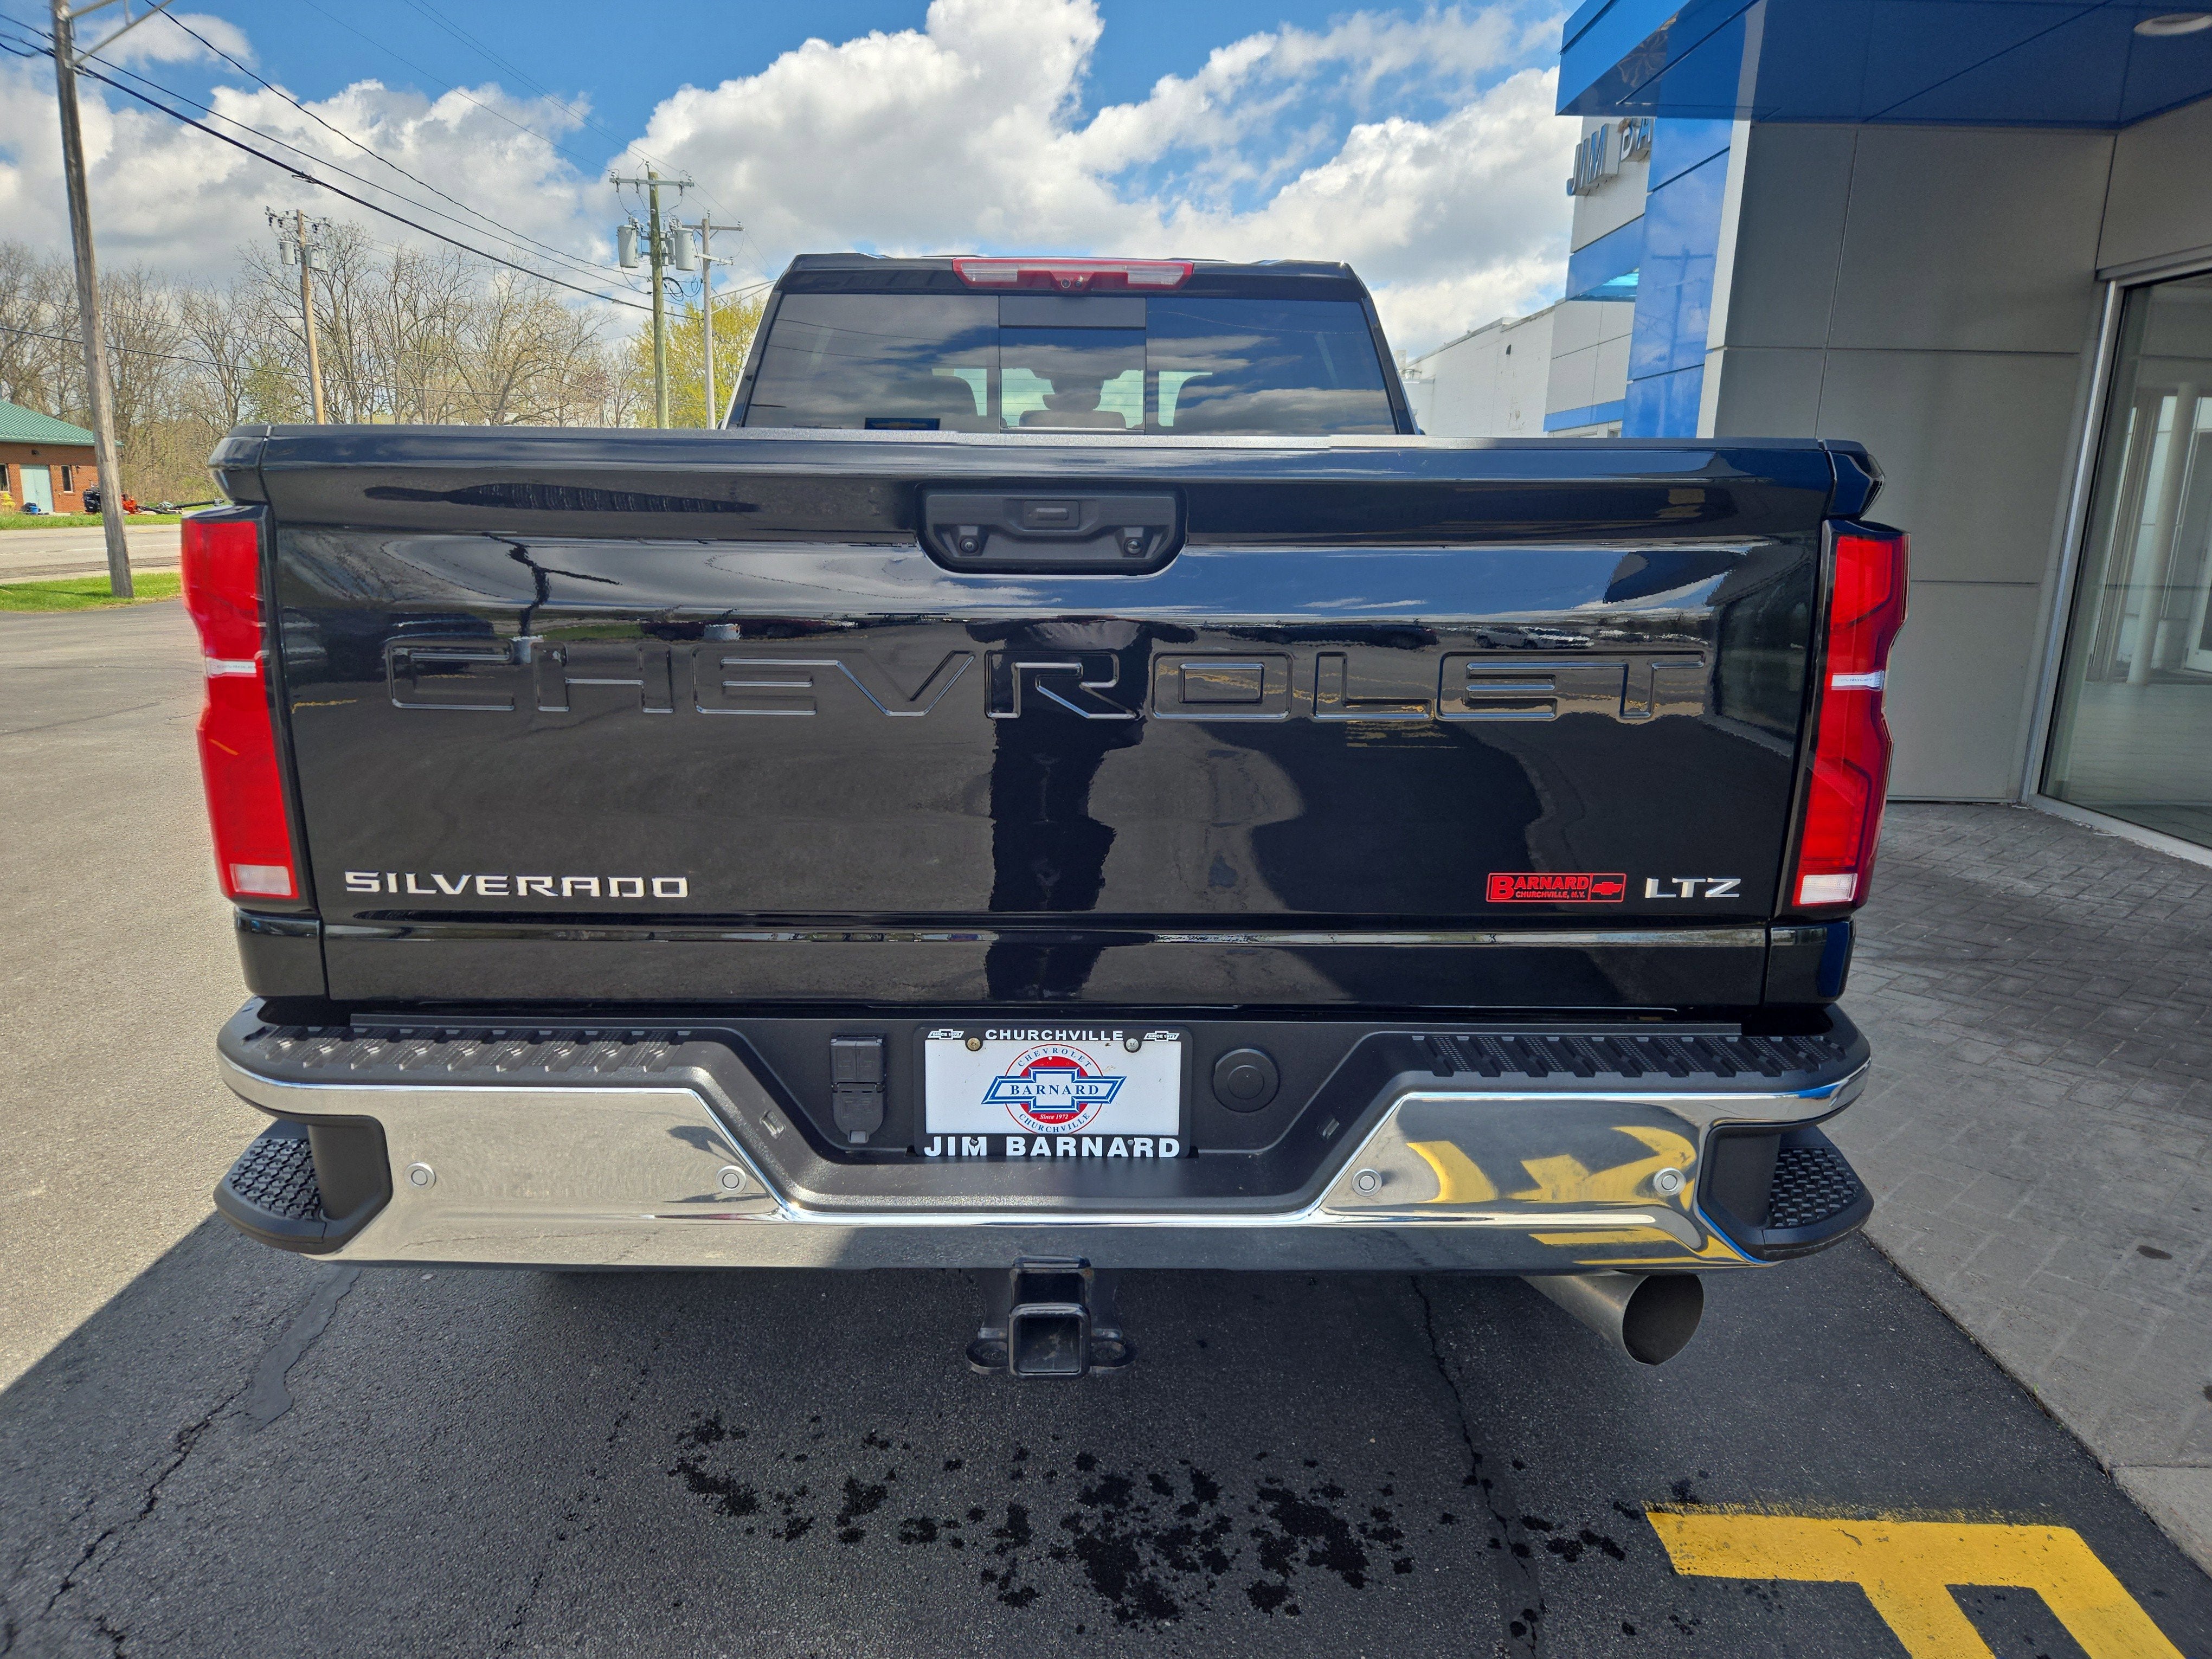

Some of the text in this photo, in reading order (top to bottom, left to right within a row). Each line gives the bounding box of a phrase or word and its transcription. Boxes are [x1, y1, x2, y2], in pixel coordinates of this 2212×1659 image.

[1567, 123, 1618, 196] JIM
[385, 640, 1707, 722] CHEVROLET
[345, 871, 690, 897] SILVERADO
[1490, 876, 1589, 899] BARNARD
[1645, 877, 1741, 898] LTZ
[1515, 891, 1570, 899] CHURCHVILLE,
[985, 1029, 1124, 1041] CHURCHVILLE
[1018, 1047, 1092, 1068] CHEVROLET
[1010, 1085, 1099, 1095] BARNARD
[1019, 1113, 1090, 1133] CHURCHVILLE
[924, 1136, 1180, 1158] JIM BARNARD
